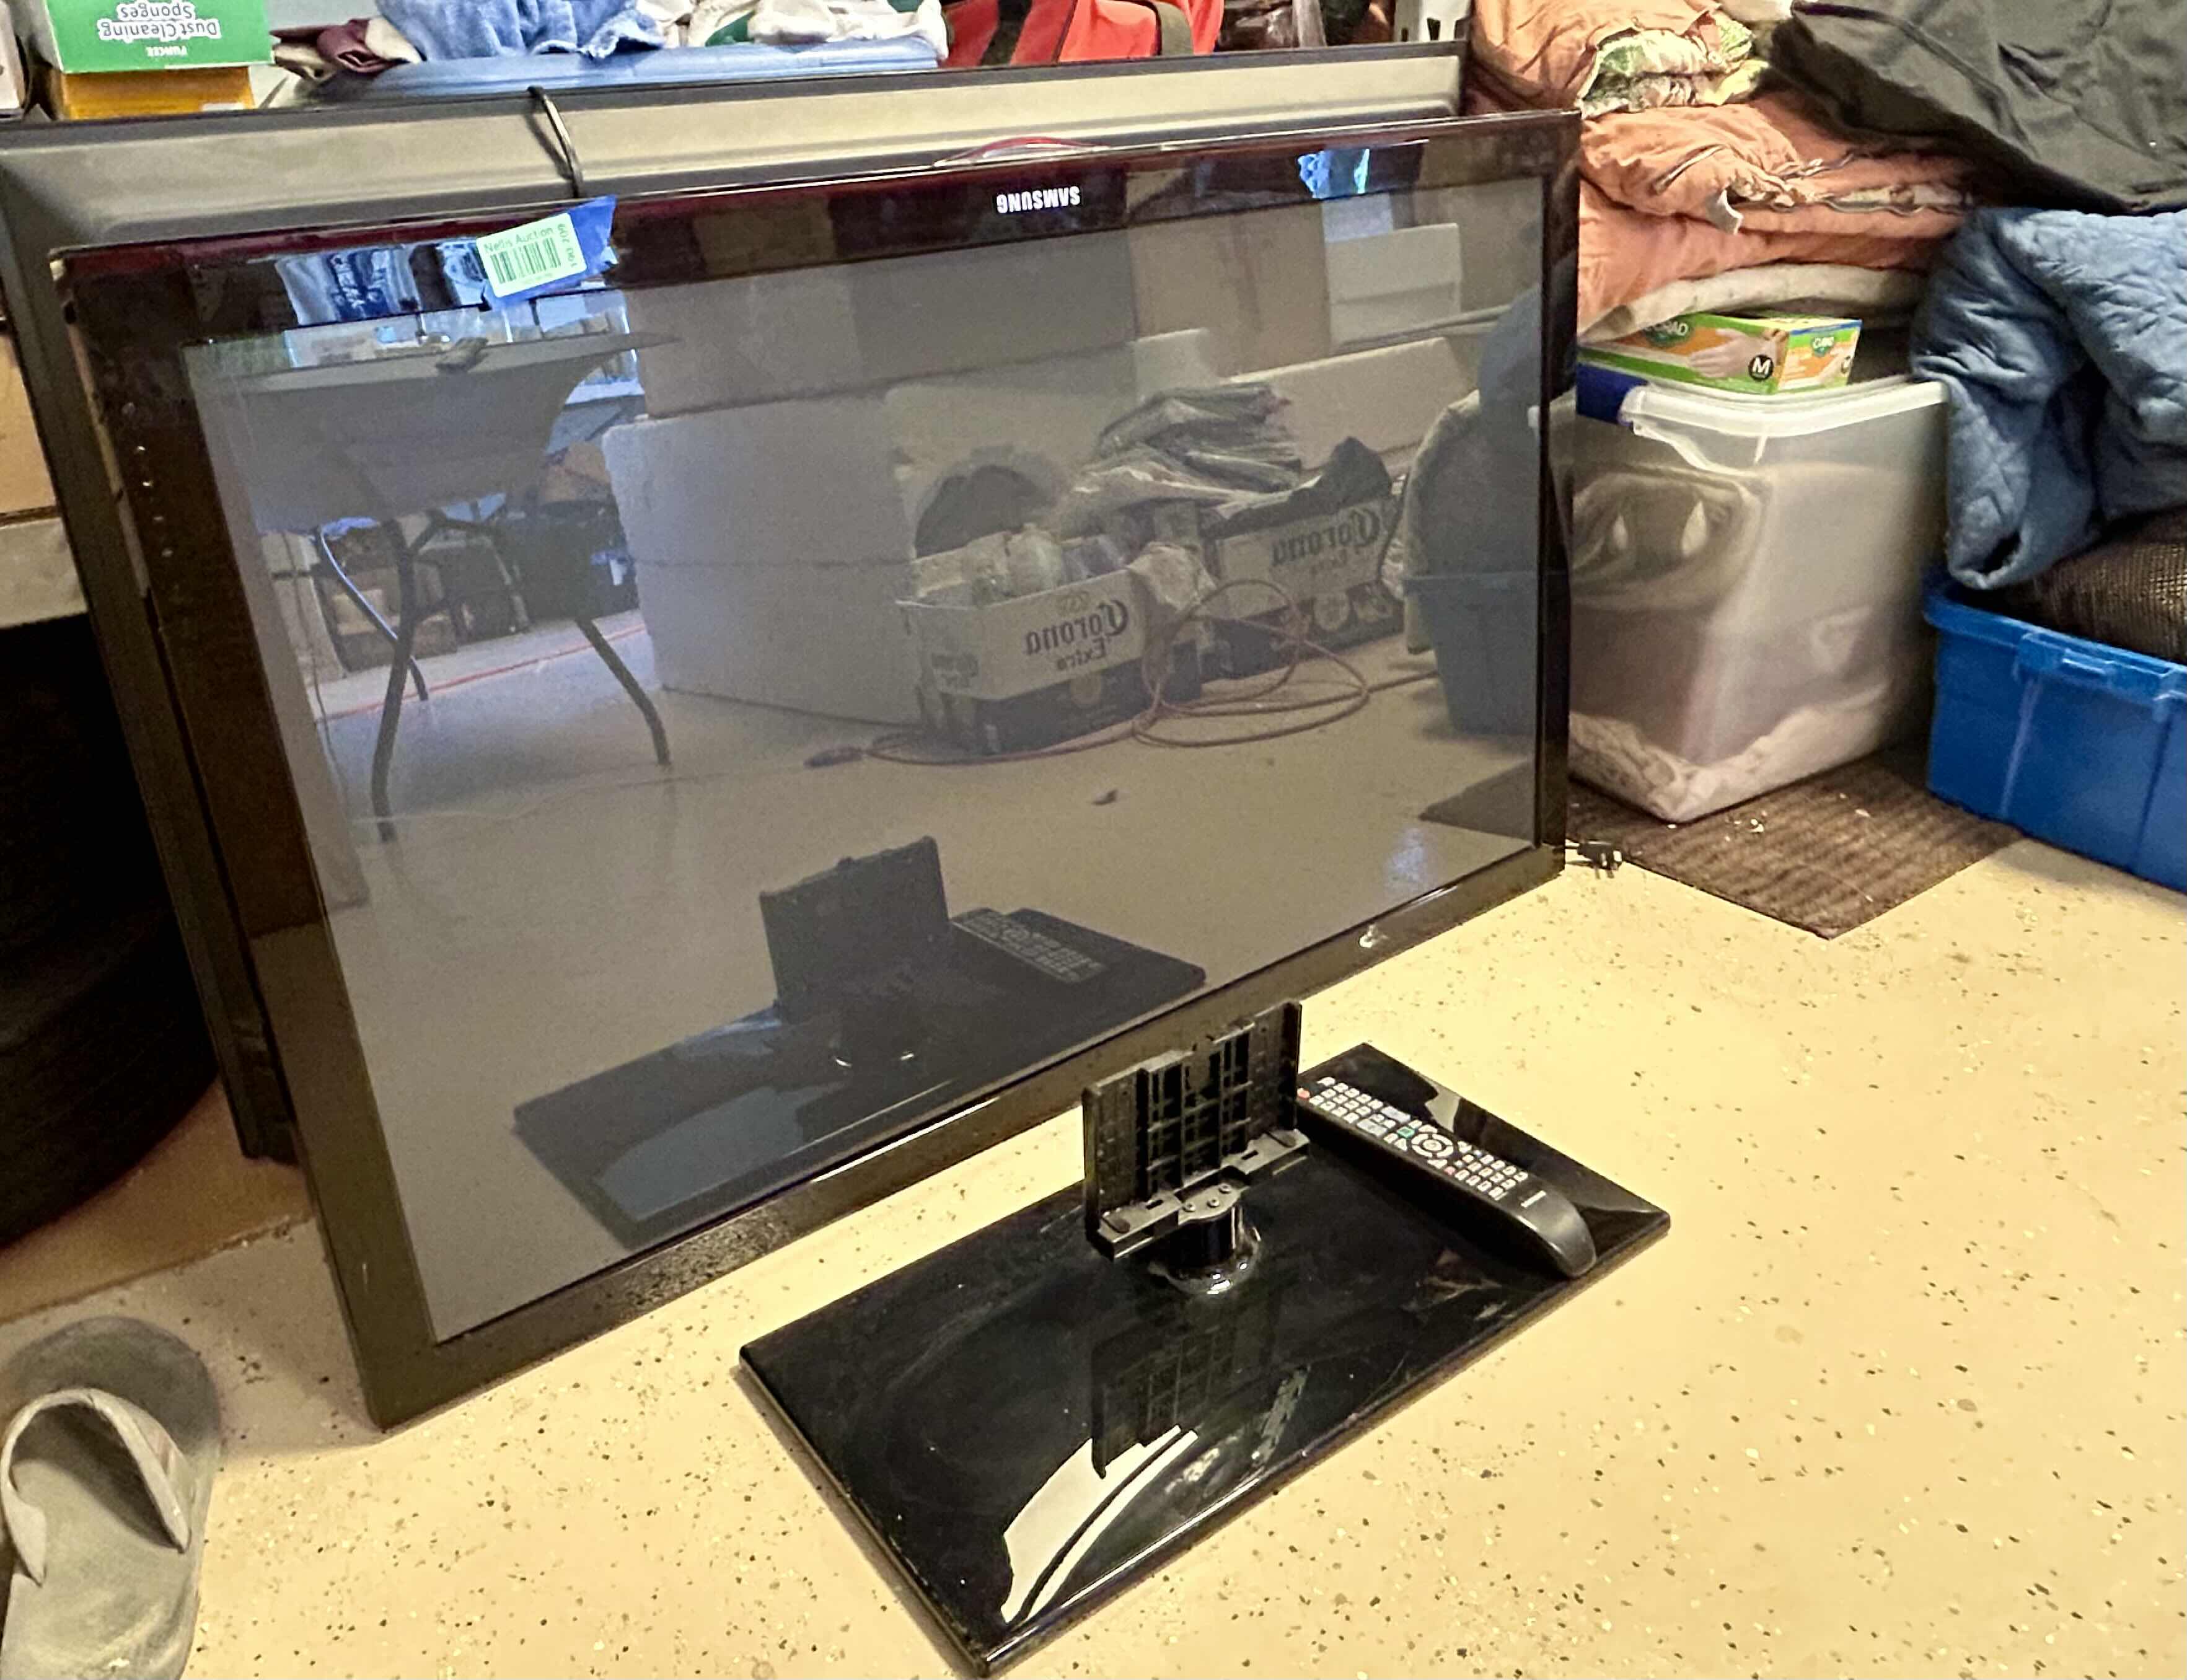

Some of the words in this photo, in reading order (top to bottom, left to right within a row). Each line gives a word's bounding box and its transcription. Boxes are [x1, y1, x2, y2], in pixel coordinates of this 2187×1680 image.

[120, 2, 193, 20] Sponges
[100, 21, 177, 38] Cleaning
[180, 22, 218, 36] Dust
[996, 185, 1081, 214] SAMSUNG
[515, 227, 553, 244] Auction
[1753, 356, 1771, 376] M
